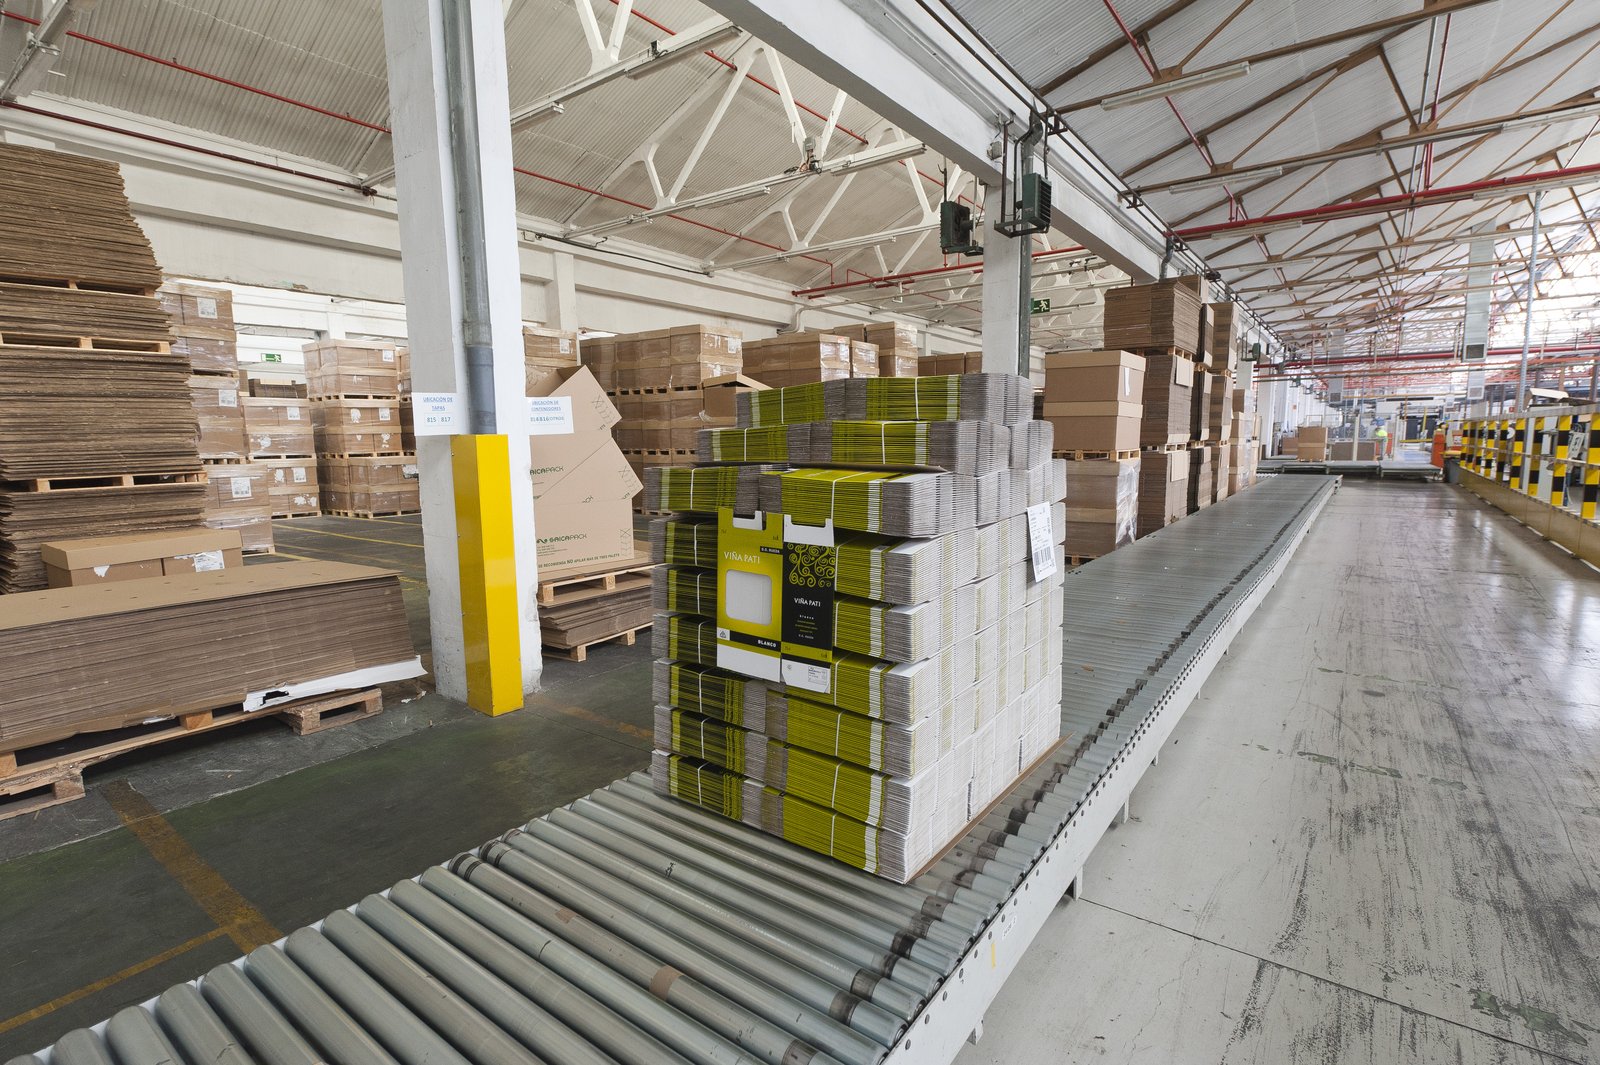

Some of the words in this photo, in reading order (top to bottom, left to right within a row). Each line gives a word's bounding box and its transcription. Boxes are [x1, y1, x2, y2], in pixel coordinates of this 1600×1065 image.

[529, 466, 564, 475] AICAPACK
[723, 551, 743, 562] VIÑA
[743, 554, 760, 564] PATI
[793, 597, 808, 605] VIÑA
[757, 639, 777, 648] BLANCO
